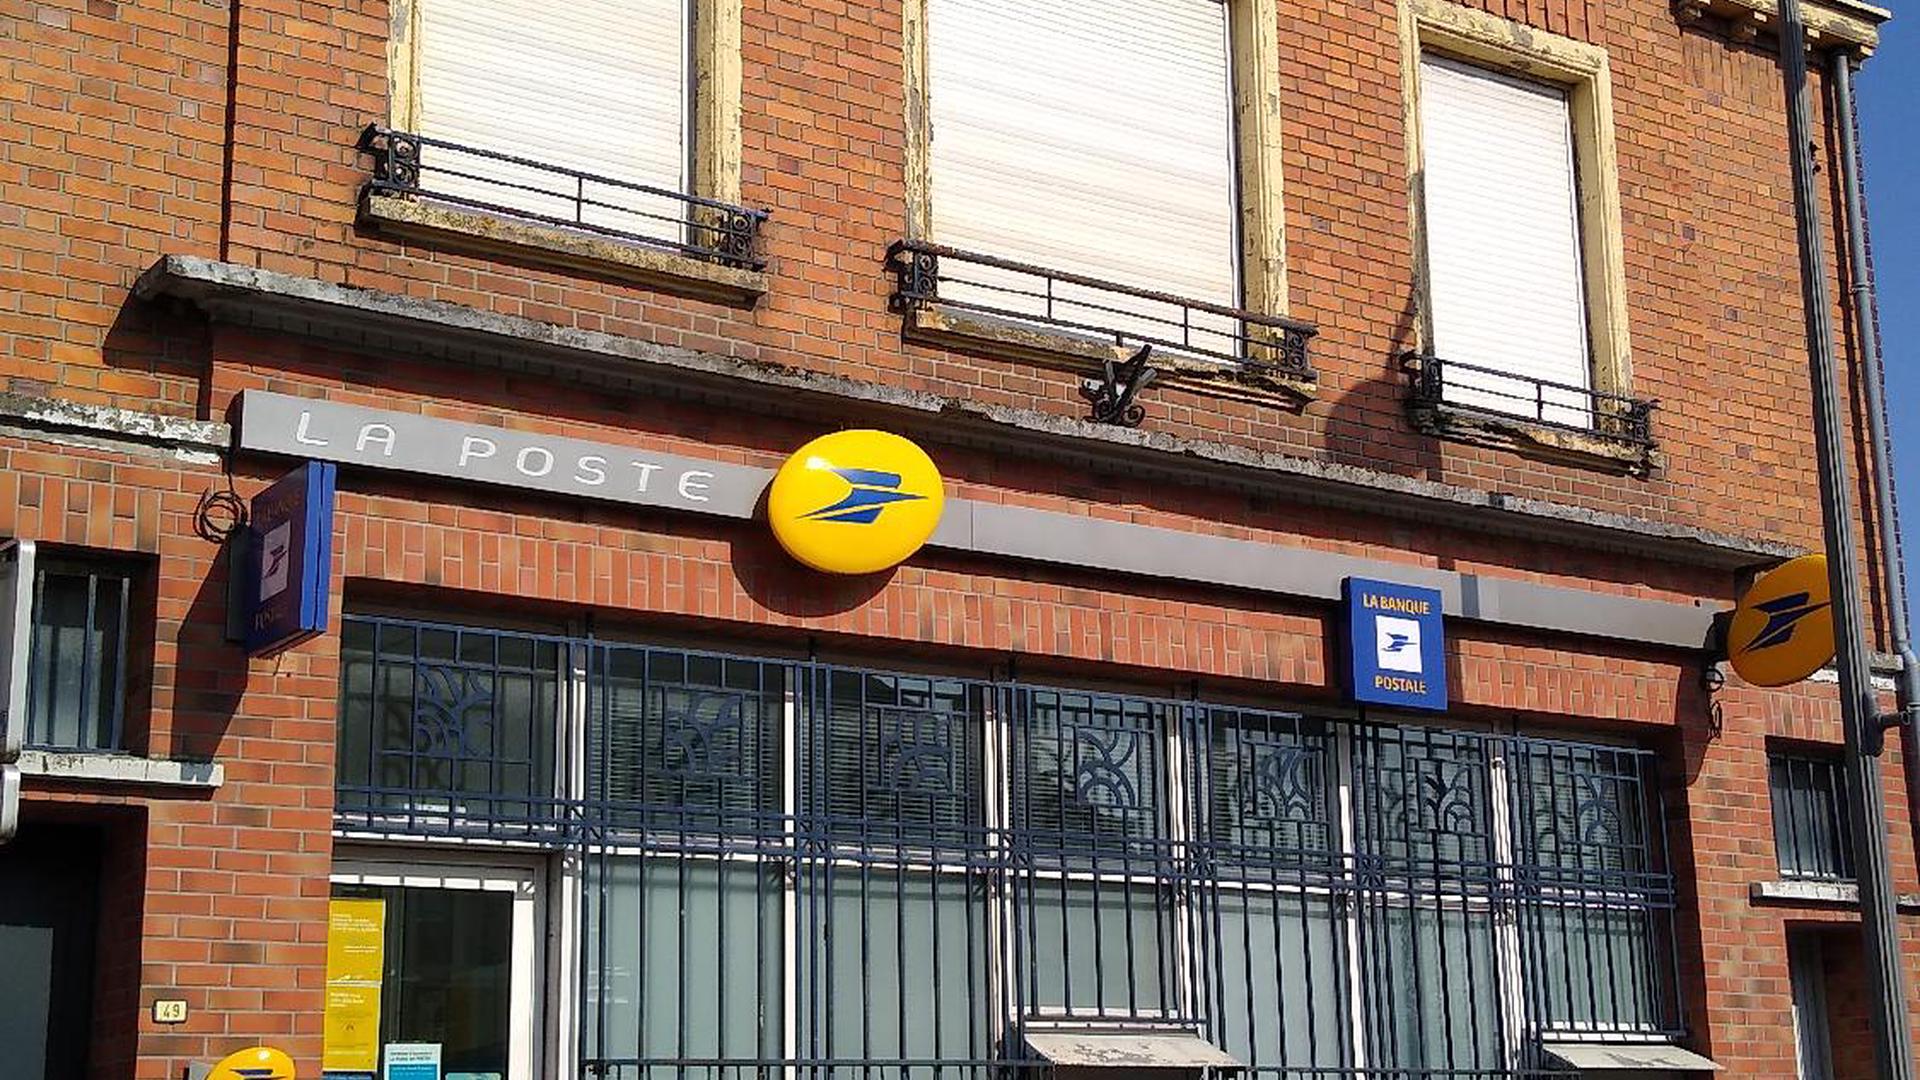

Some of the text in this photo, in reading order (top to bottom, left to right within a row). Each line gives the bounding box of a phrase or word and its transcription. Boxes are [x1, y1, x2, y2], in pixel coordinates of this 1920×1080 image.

[295, 411, 715, 502] LA POSTE
[1363, 593, 1431, 615] LA BANQUE
[1375, 675, 1427, 694] POSTALE
[163, 1003, 180, 1018] 49
